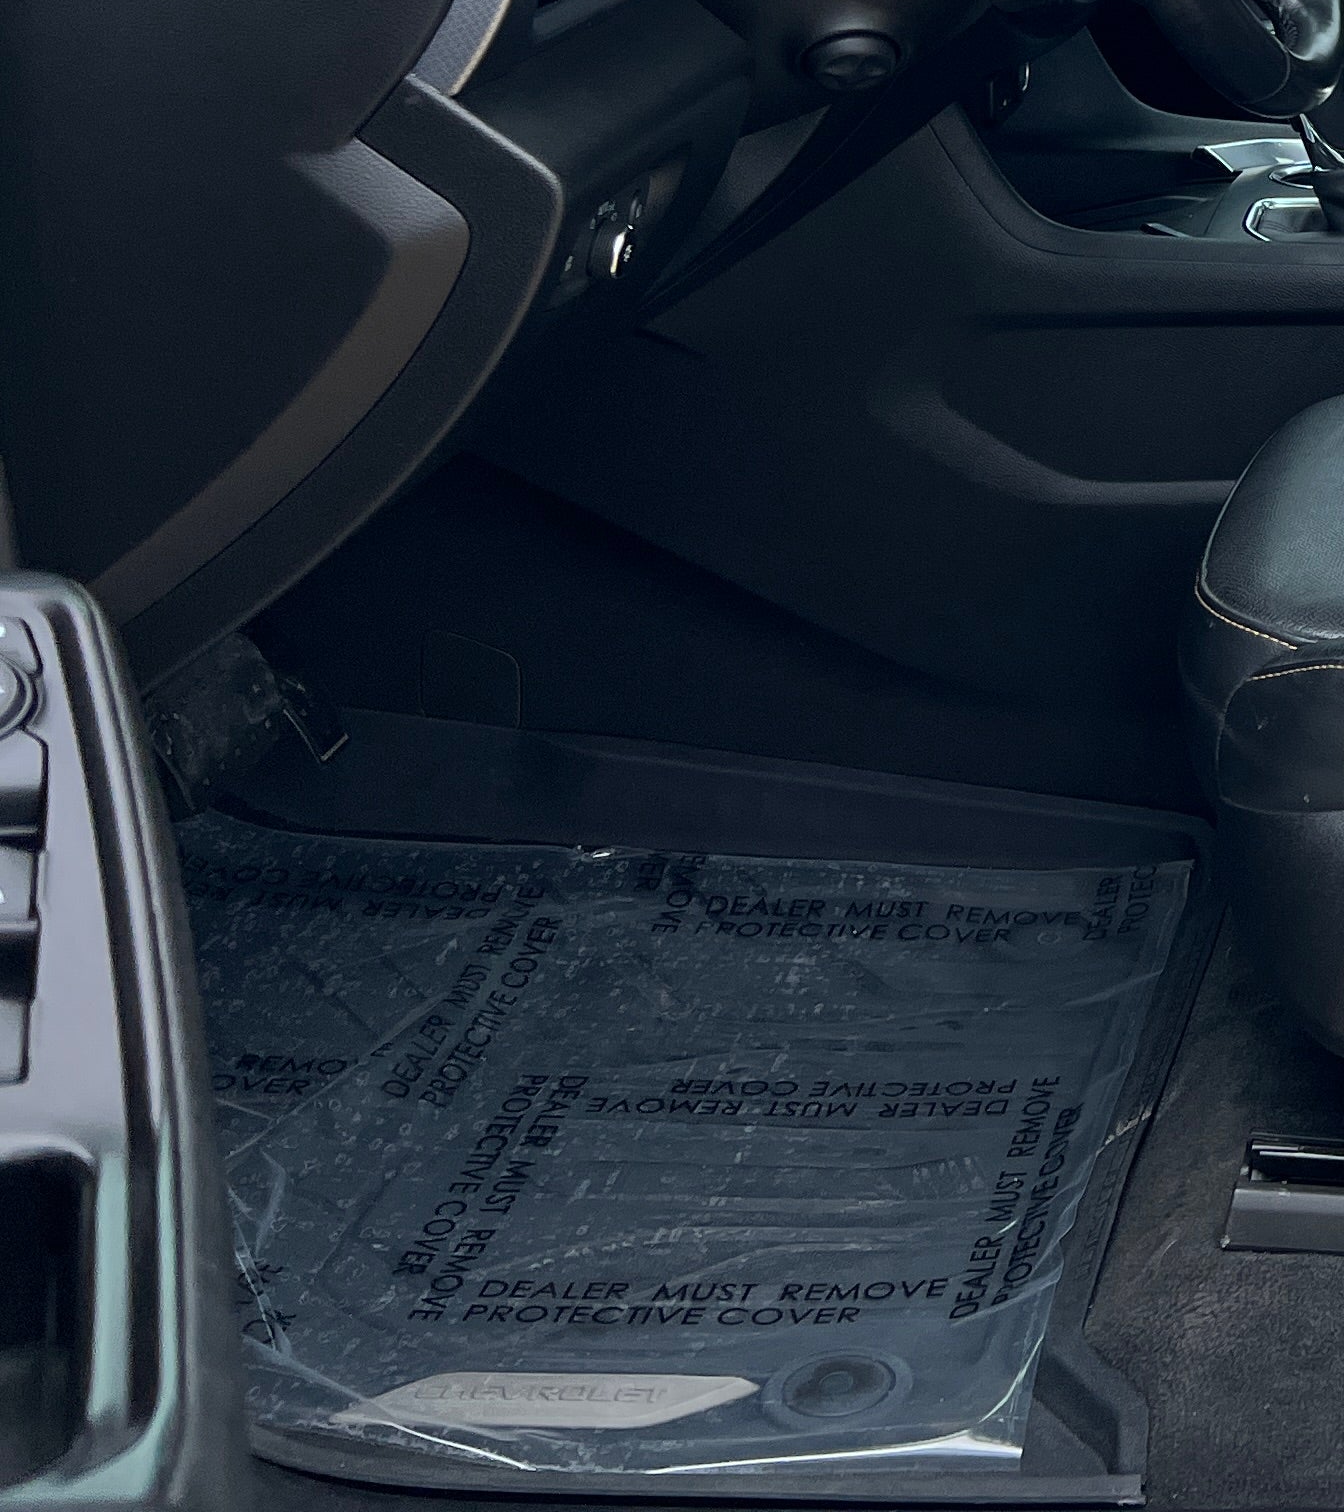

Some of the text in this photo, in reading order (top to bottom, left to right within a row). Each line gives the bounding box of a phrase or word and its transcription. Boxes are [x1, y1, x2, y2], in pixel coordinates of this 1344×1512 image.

[705, 896, 1083, 926] DEALER MUST REMOVE
[696, 921, 1013, 944] PROTECTIVE COVER
[418, 916, 564, 1110] PROTECTIVE COVER
[382, 1015, 456, 1099] DEALER
[443, 963, 491, 1011] MUST
[211, 1074, 311, 1096] OVER
[670, 1077, 1018, 1098] PROTECTIVE COVER
[584, 1096, 1009, 1118] DEALER MUST REMOVE
[392, 1074, 550, 1275] PROTECTIVE COVER
[407, 1075, 590, 1321] DEALER MUST REMOVE
[949, 1075, 1061, 1320] DEALER MUST REMOVE
[478, 1277, 951, 1303] DEALER MUST REMOVE
[462, 1303, 862, 1326] PROTECTIVE COVER
